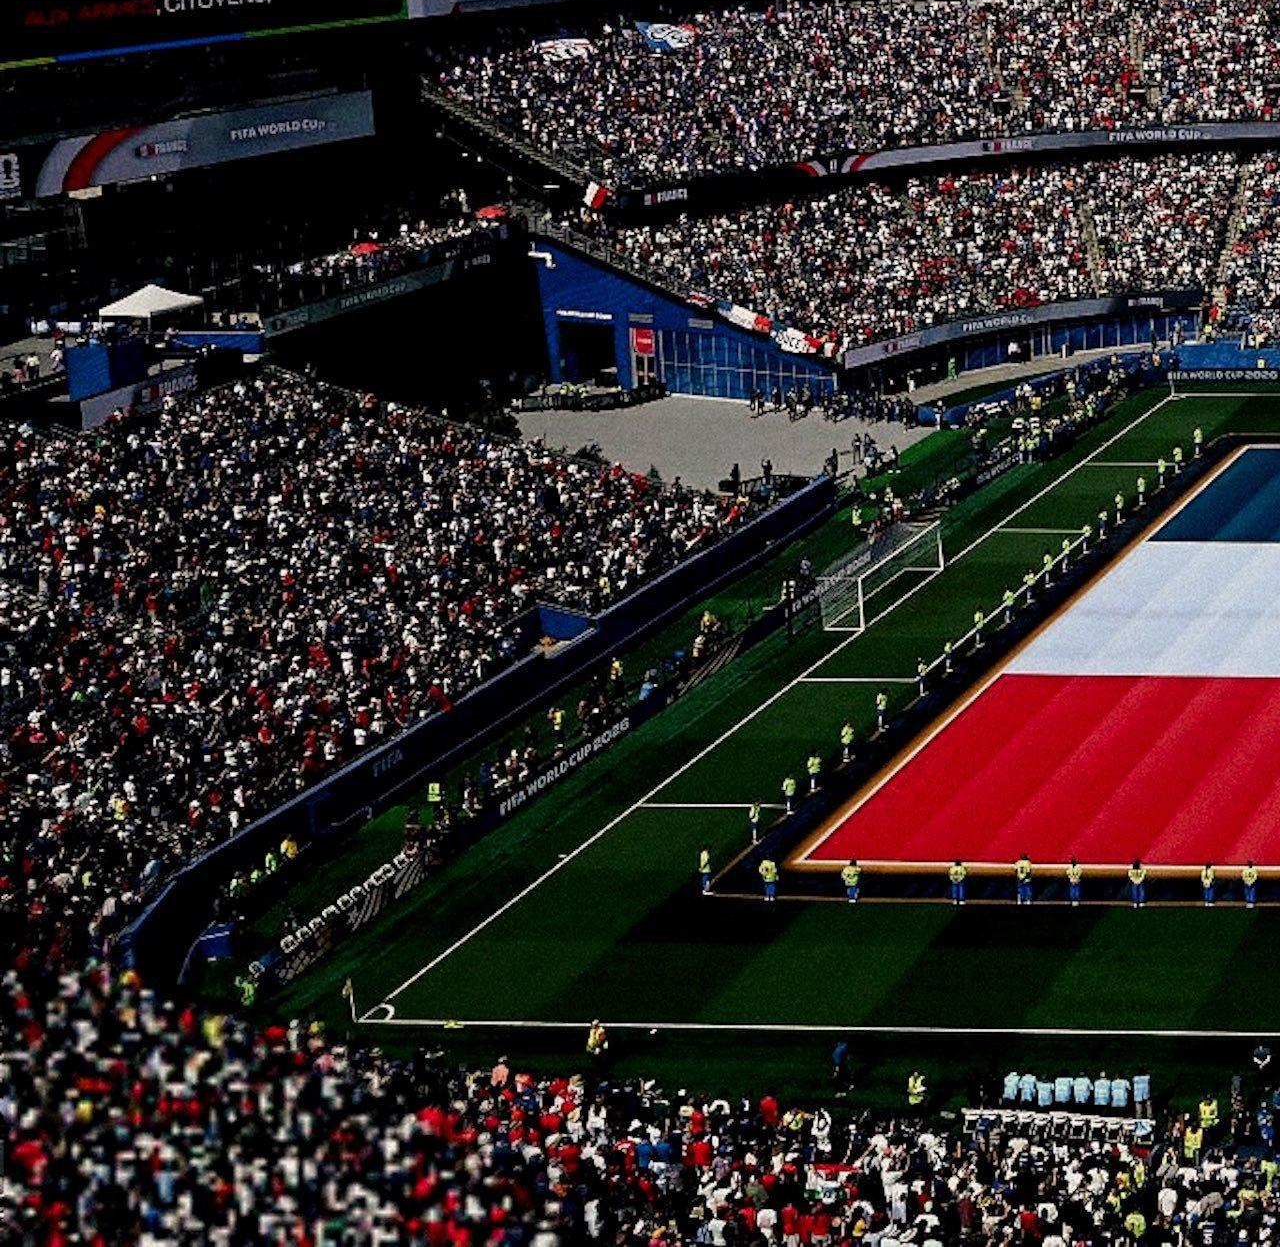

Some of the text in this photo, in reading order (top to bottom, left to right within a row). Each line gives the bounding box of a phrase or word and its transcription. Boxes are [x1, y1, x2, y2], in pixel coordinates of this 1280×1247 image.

[373, 749, 404, 777] FIFA
[499, 717, 630, 816] FIFA WORLD CUP 2026
